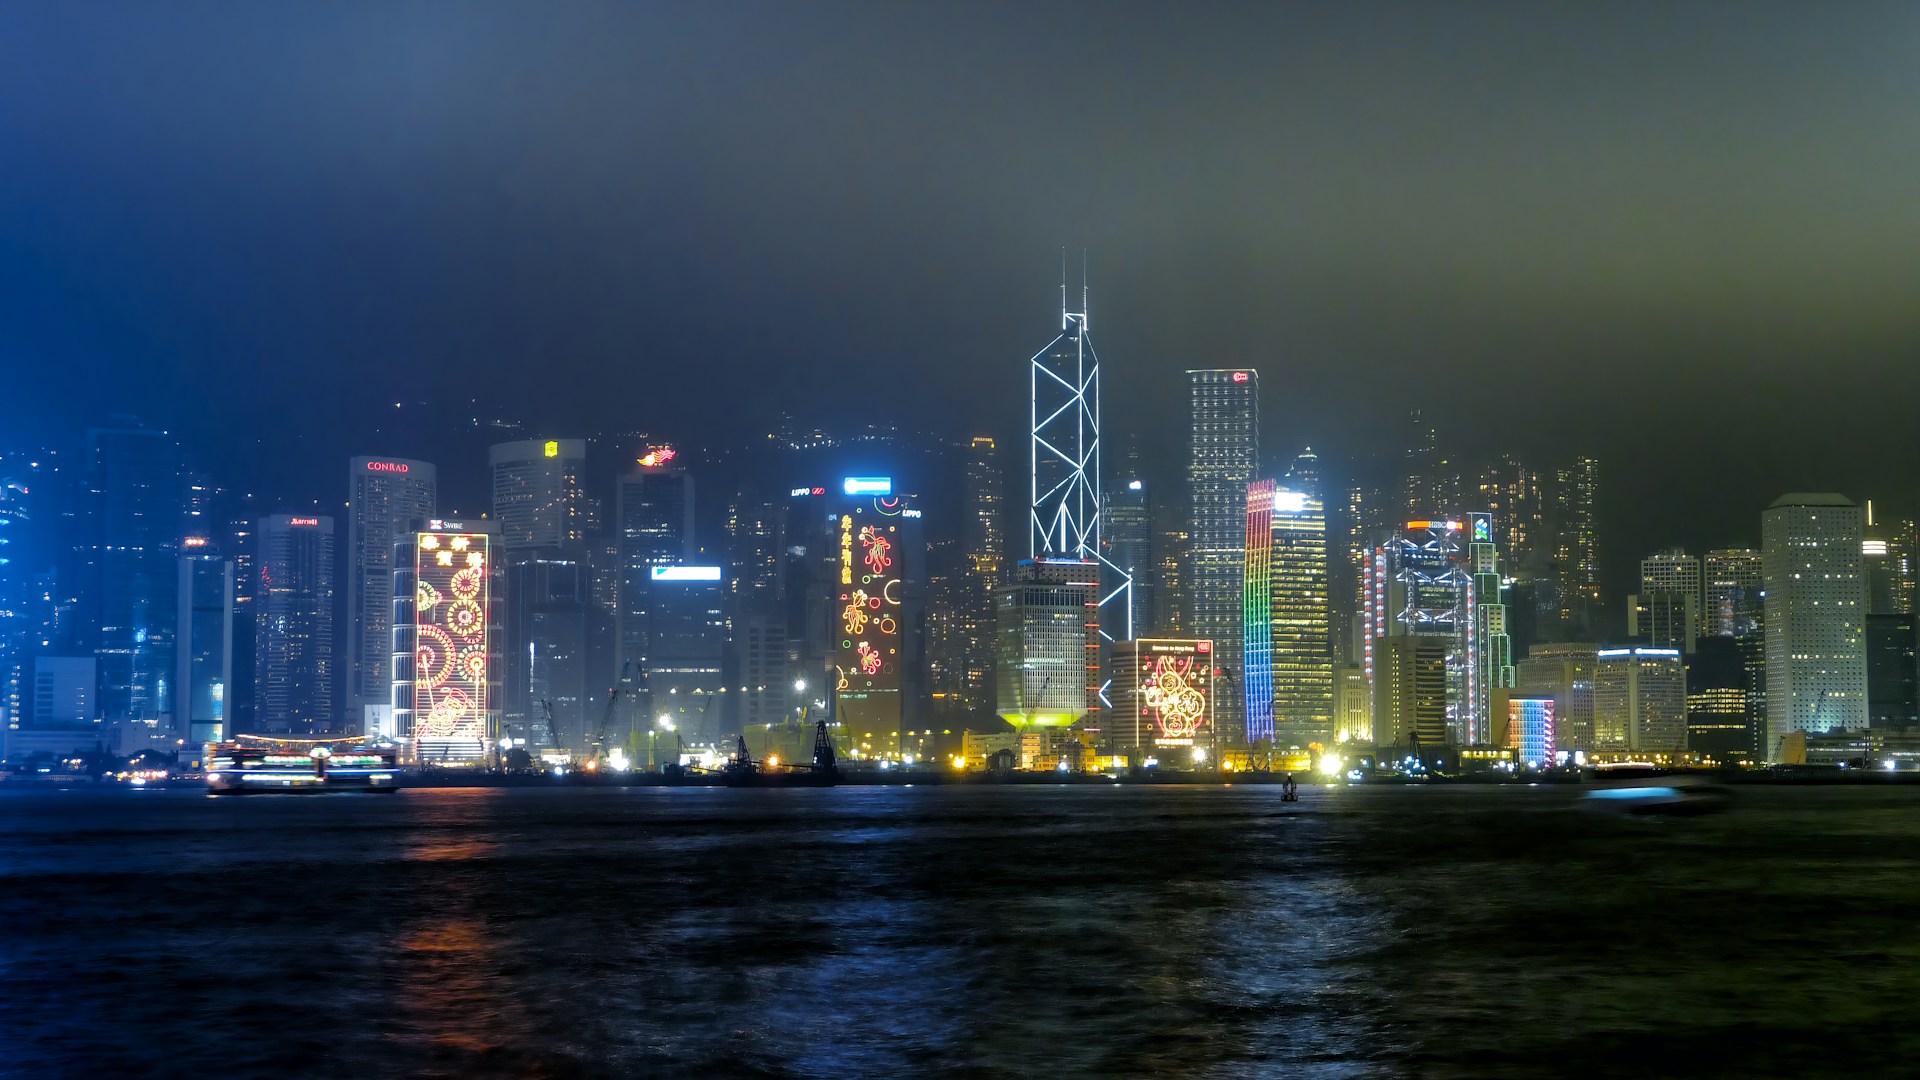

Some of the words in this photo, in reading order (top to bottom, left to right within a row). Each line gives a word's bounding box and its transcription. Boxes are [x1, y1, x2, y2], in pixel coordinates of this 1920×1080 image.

[367, 461, 409, 473] CONRAD
[791, 488, 810, 497] LIPPO
[902, 509, 921, 518] LIPPO
